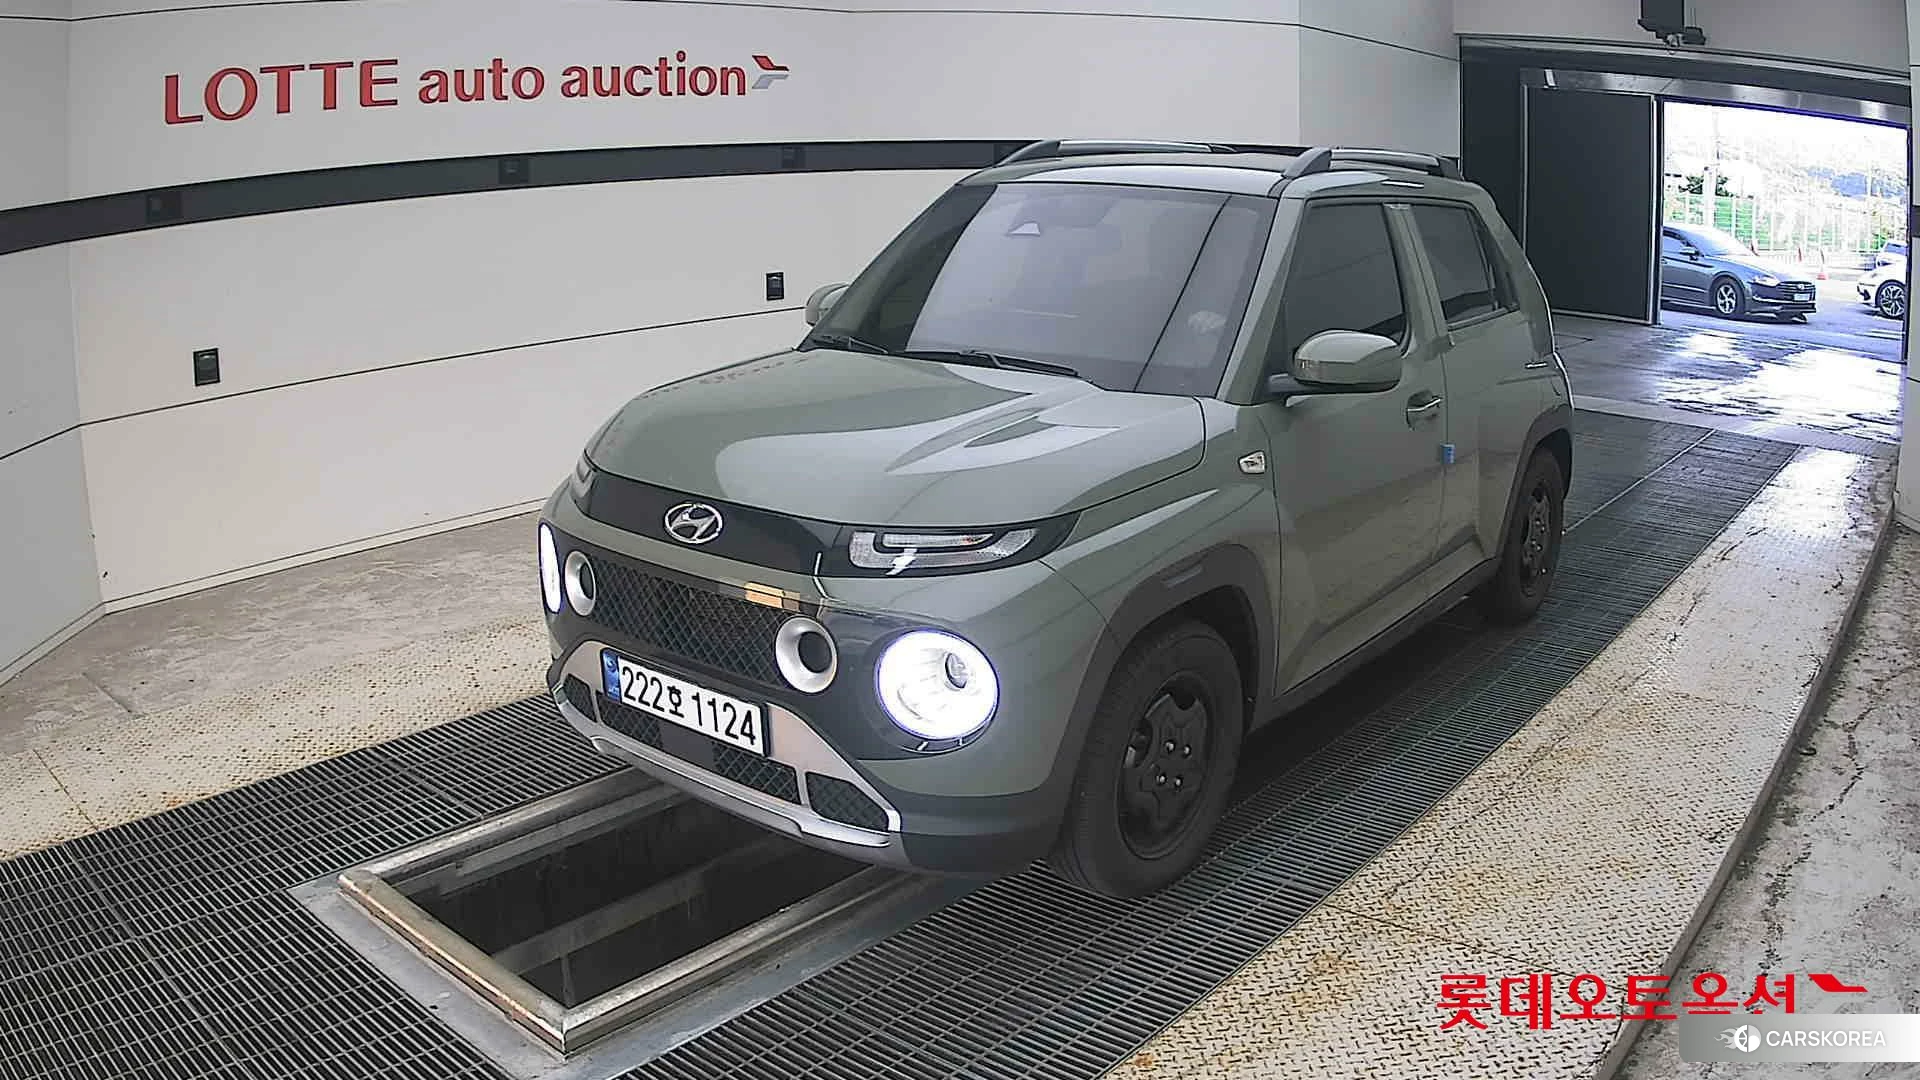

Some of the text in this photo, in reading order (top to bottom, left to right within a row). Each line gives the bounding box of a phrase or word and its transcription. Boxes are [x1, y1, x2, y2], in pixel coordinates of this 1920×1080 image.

[165, 50, 747, 124] LOTTE auto auction
[691, 692, 756, 746] 1124
